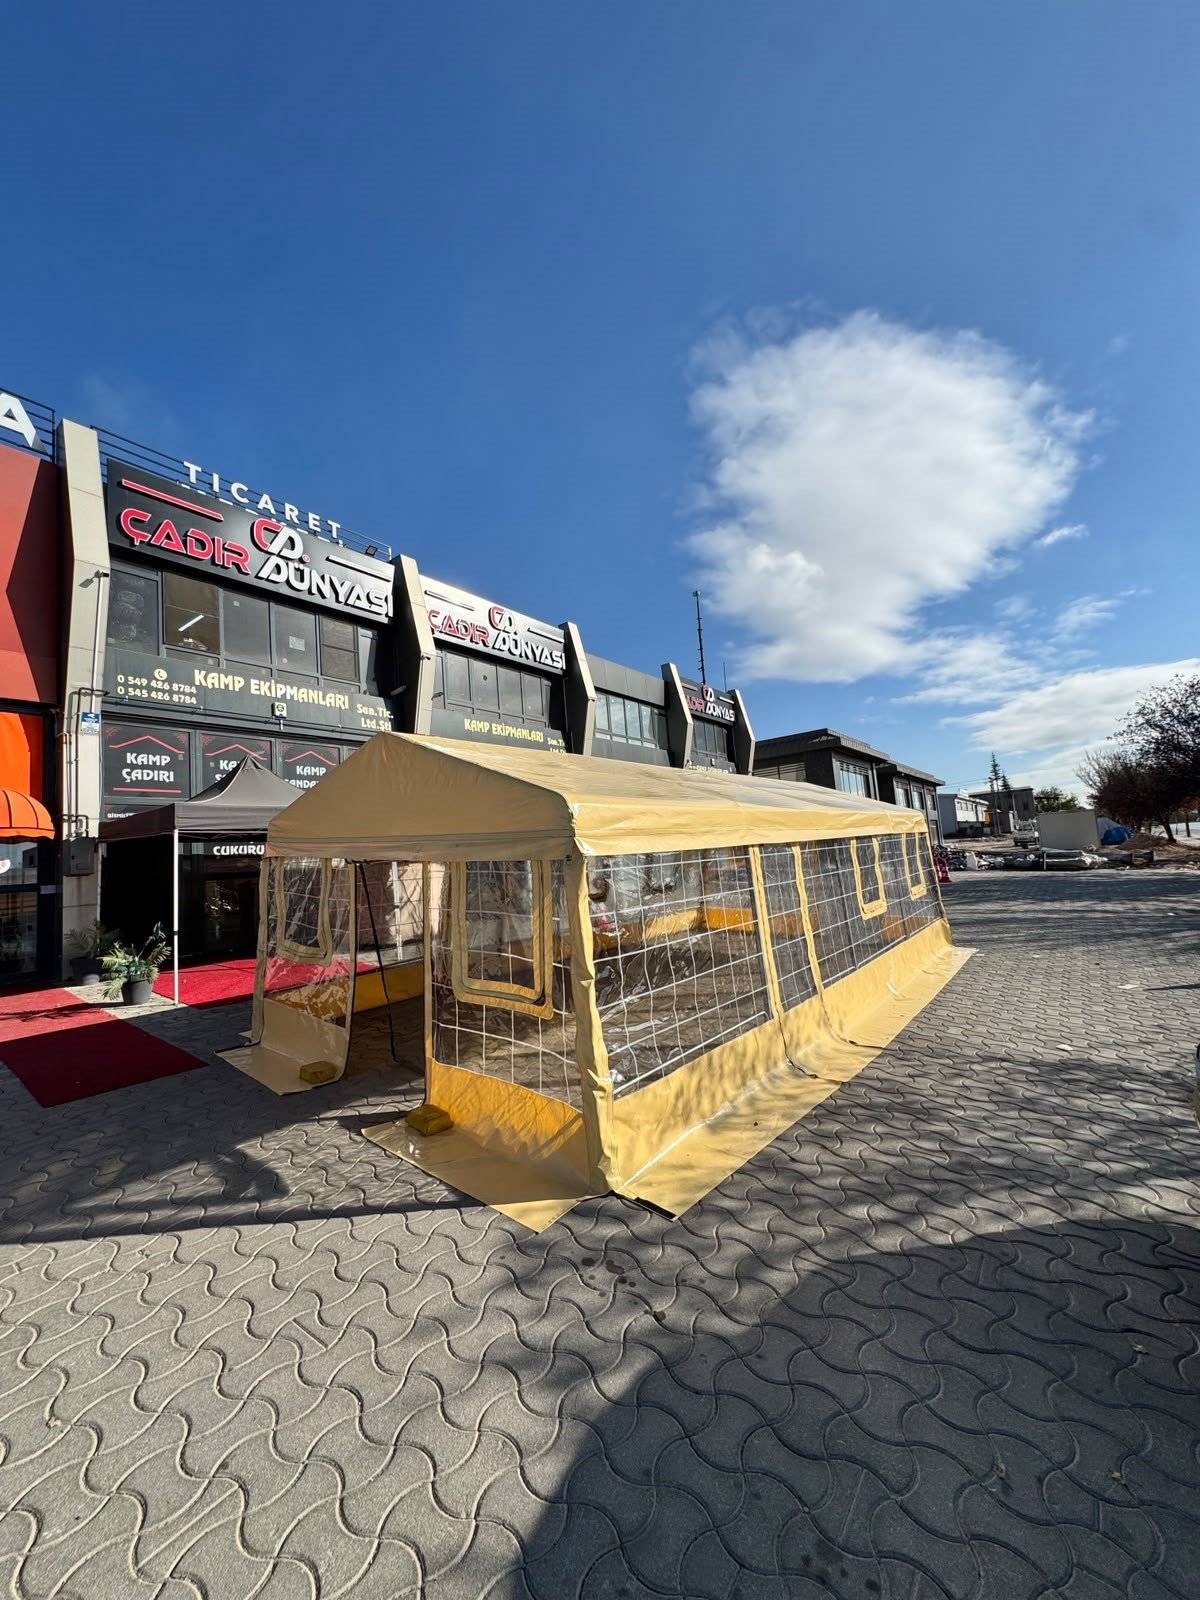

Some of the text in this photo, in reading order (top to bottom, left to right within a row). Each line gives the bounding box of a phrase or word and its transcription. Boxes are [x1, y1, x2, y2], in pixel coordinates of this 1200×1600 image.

[184, 461, 341, 539] TICARET
[121, 508, 394, 618] ÇADIR DÜNYASI
[117, 675, 197, 694] 0 549 426 8784
[194, 670, 349, 710] KAMP EKİPMANLARI
[117, 686, 197, 705] 0 545 426 8784
[463, 719, 544, 742] KAMP EKİPMANLARI
[126, 752, 171, 766] KAMP
[219, 759, 240, 771] KA
[121, 768, 175, 782] ÇADIRI
[296, 765, 327, 777] KAMP
